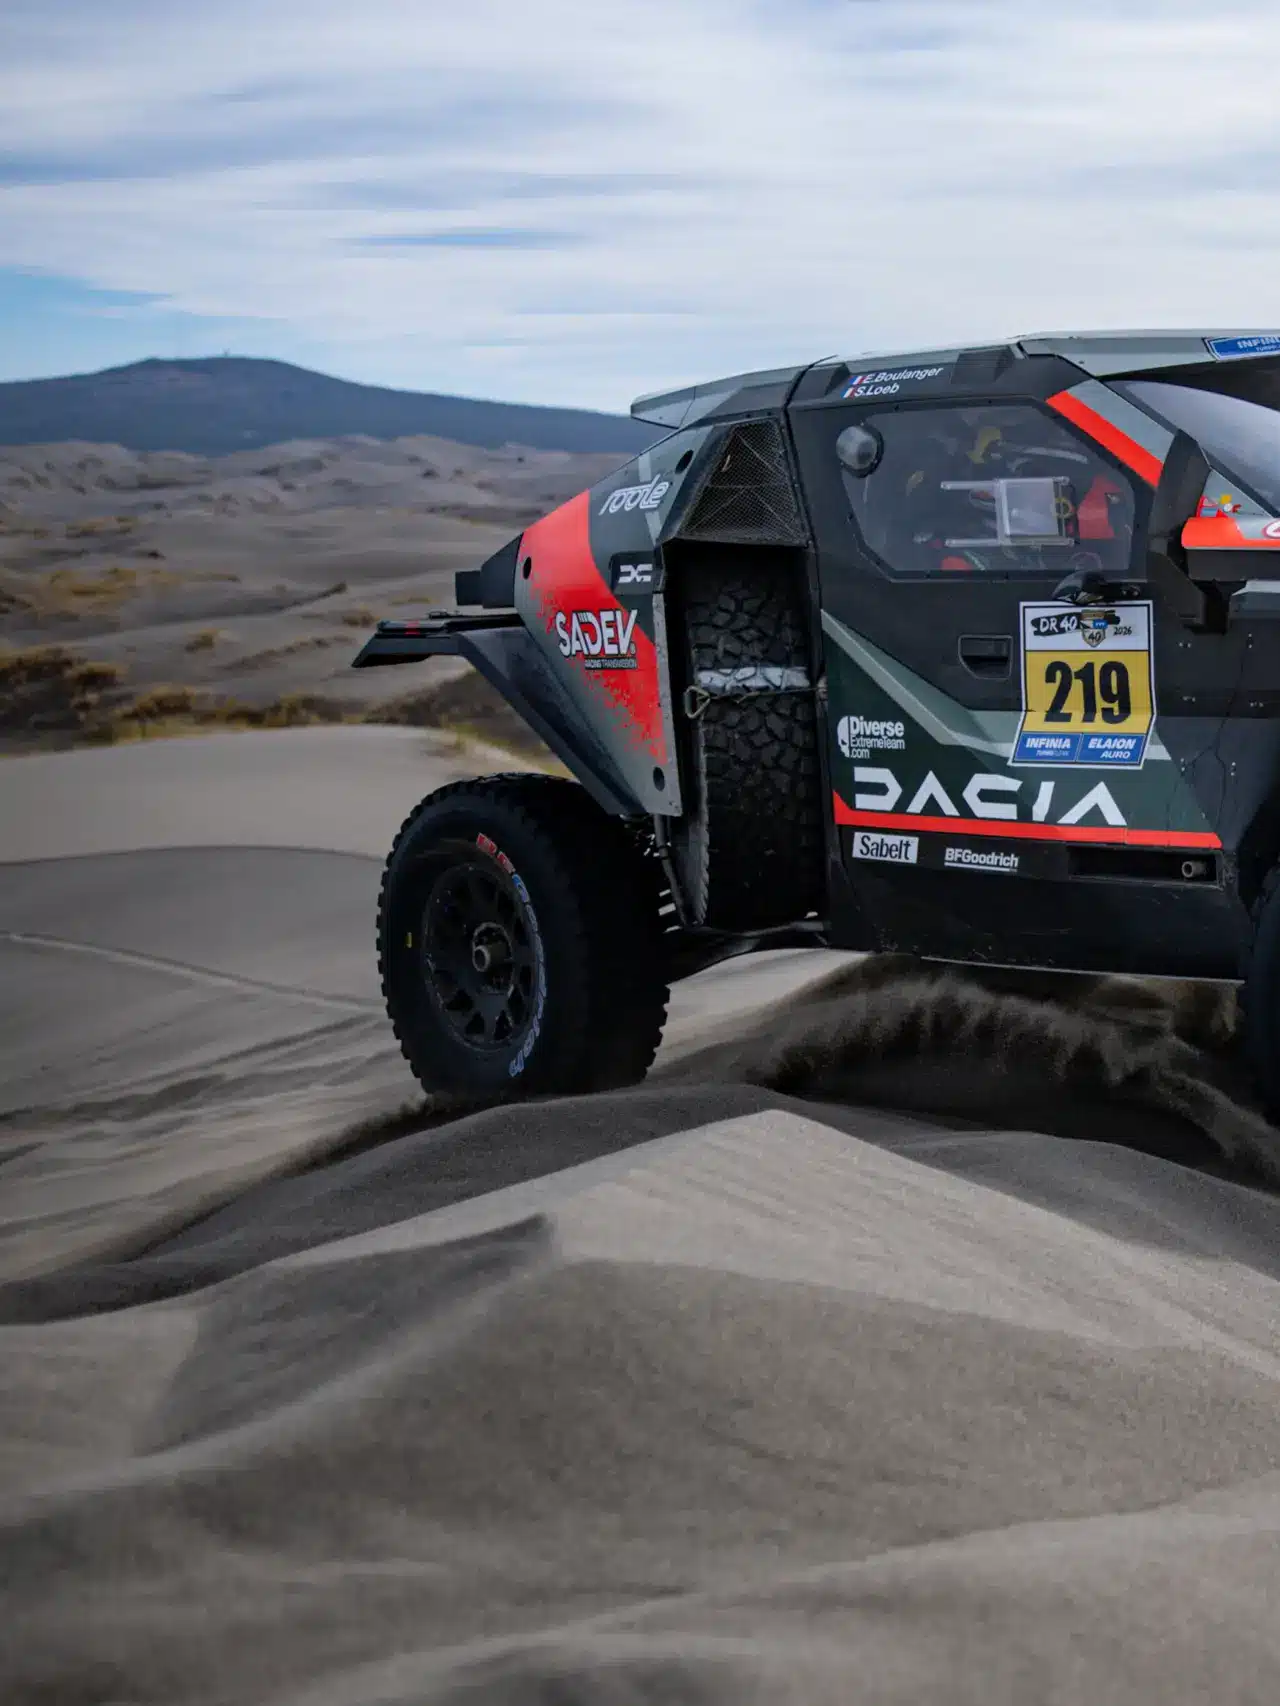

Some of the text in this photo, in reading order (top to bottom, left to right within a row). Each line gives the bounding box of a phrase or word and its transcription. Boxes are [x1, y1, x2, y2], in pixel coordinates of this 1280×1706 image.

[863, 367, 944, 383] E.Boulanger
[854, 382, 900, 397] S.Loeb
[1039, 617, 1059, 633] DR
[1060, 615, 1077, 632] 40
[1113, 625, 1132, 636] 2026
[555, 609, 638, 656] SADEV
[1087, 631, 1101, 642] 40
[1044, 660, 1132, 724] 219
[850, 715, 905, 737] Diverse
[850, 735, 906, 750] ExtremeTeam
[1025, 738, 1136, 749] INFINIA ELAION
[850, 748, 870, 759] .com
[1100, 750, 1131, 759] AURO
[854, 766, 1128, 826] DACIA
[859, 835, 912, 860] Sabelt
[944, 847, 1019, 868] BFGoodrich
